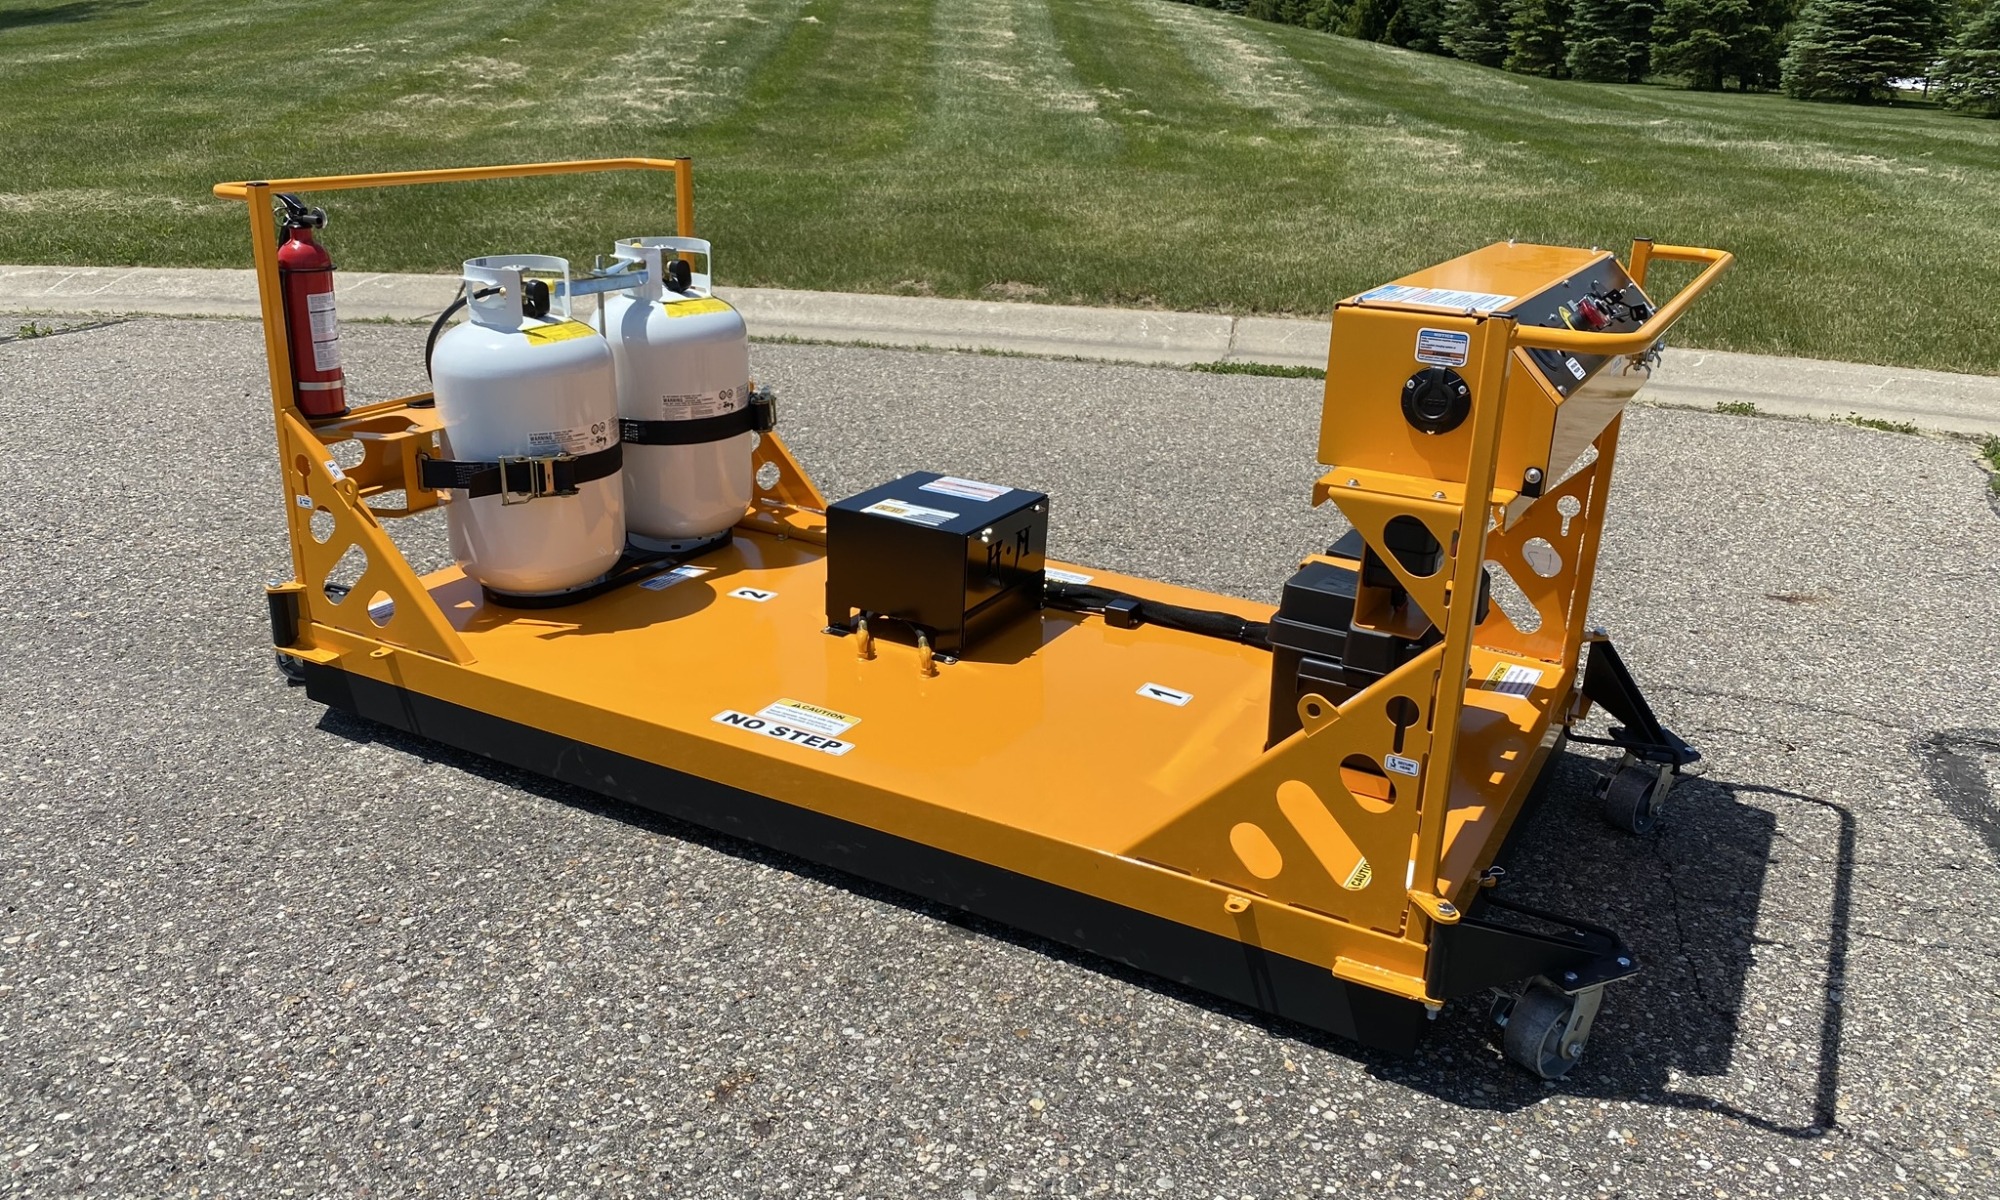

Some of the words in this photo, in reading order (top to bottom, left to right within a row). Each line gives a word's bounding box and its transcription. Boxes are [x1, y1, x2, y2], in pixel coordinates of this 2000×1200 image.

[738, 590, 769, 599] 2
[1149, 688, 1183, 700] 1
[801, 704, 846, 720] CAUTION
[722, 713, 766, 730] NO
[768, 726, 843, 750] STEP
[1350, 863, 1372, 887] CAUTIO
